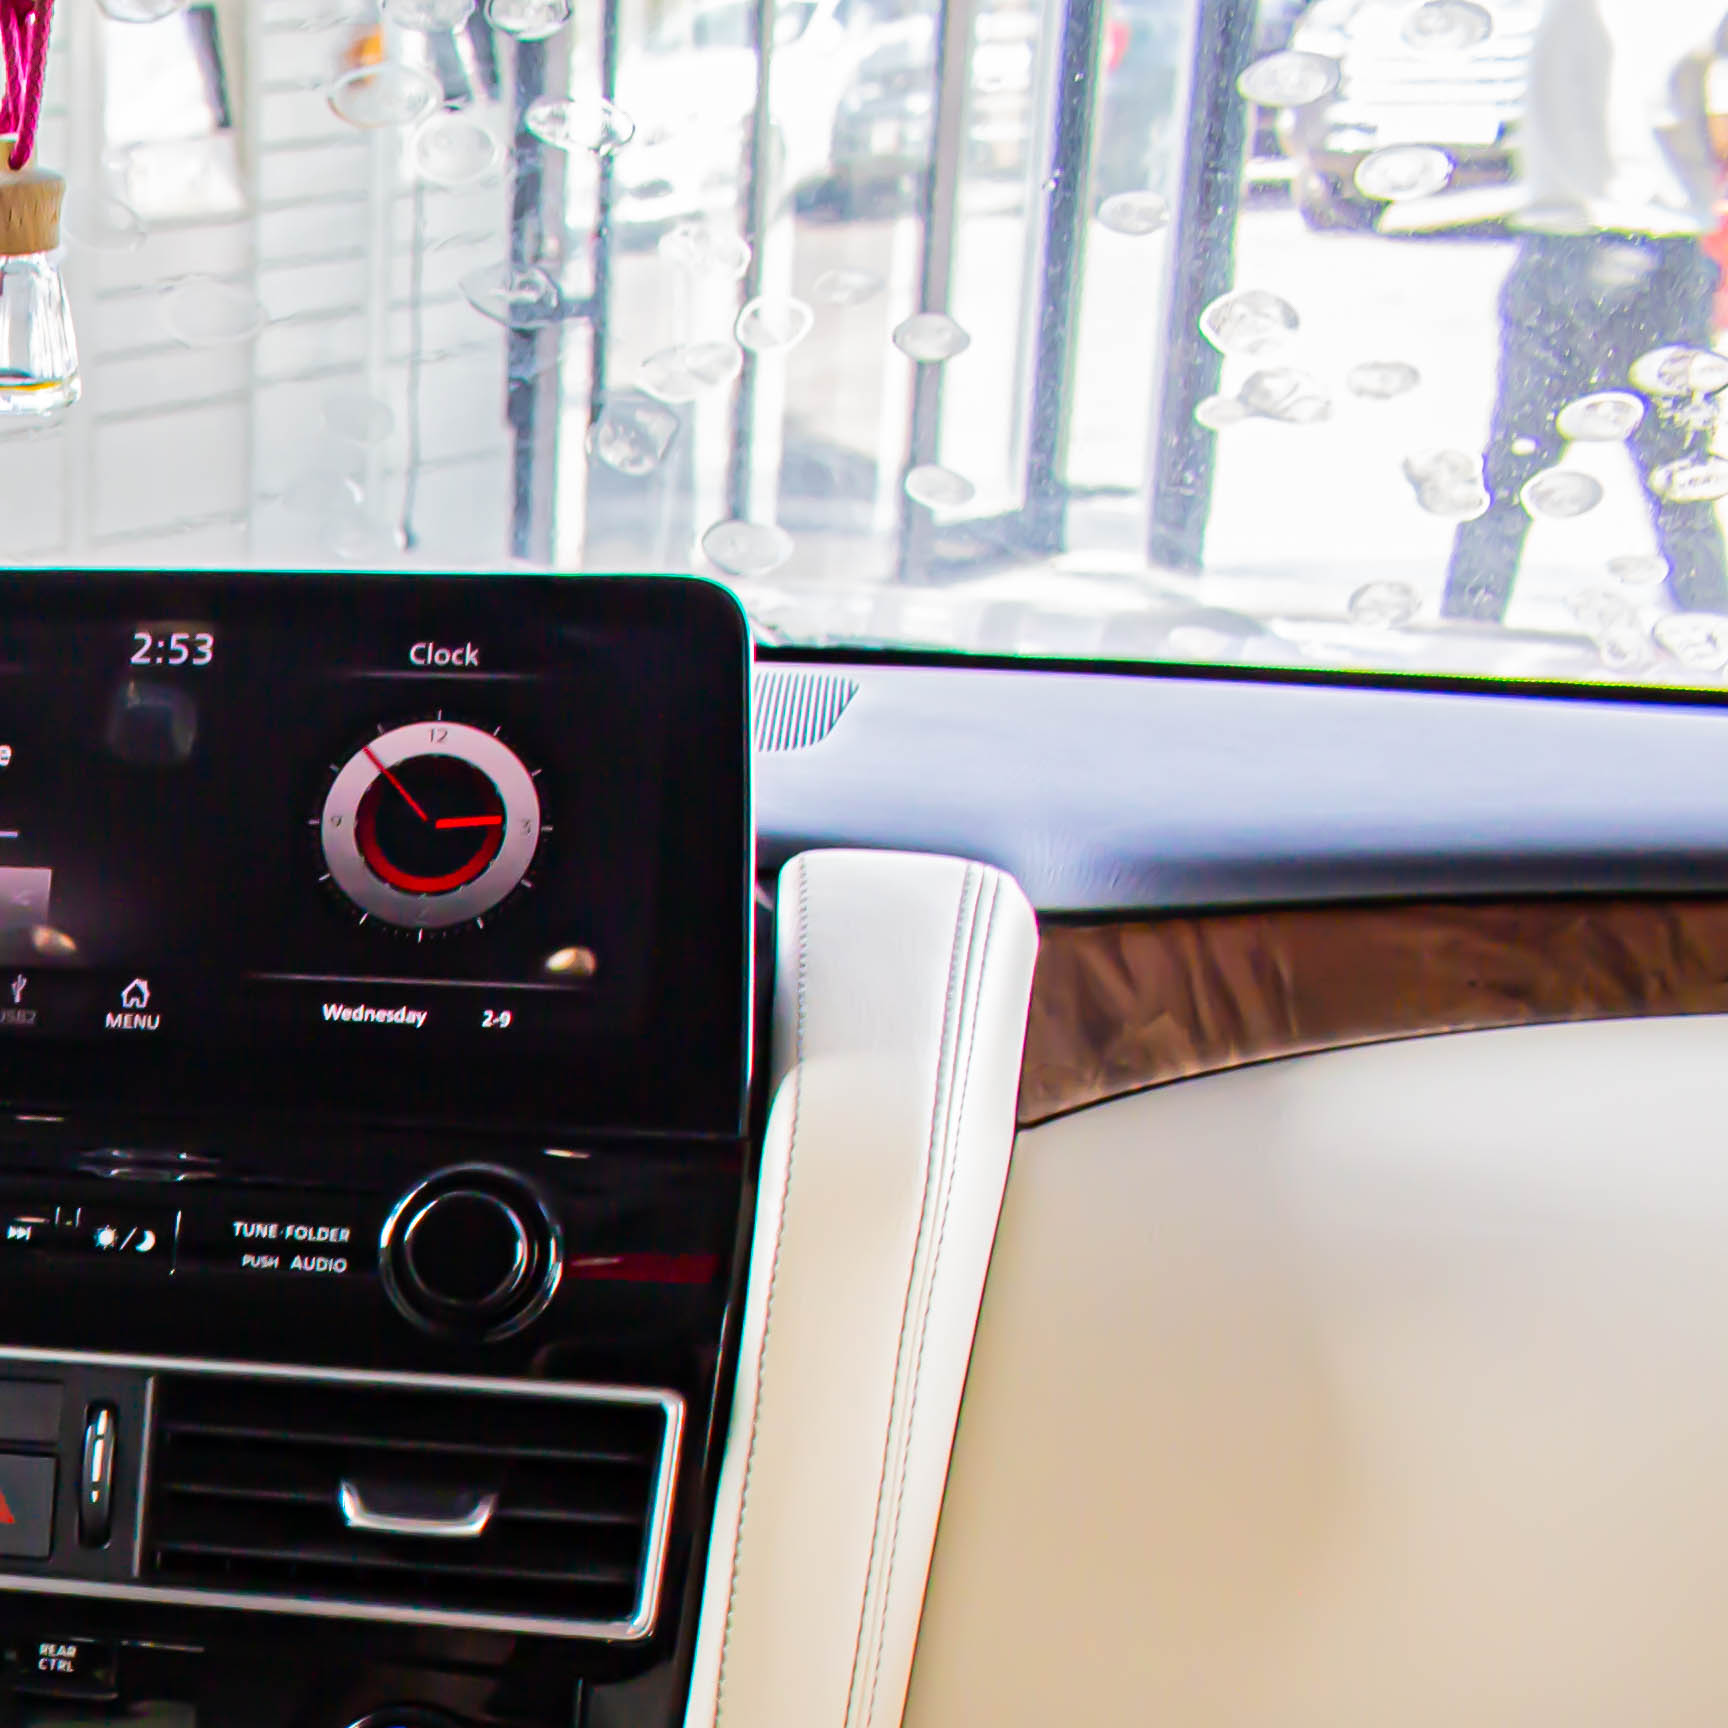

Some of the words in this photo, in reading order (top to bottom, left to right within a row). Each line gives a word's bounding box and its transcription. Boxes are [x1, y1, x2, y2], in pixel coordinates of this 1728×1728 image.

[130, 632, 215, 666] 2:53
[409, 642, 479, 667] Clock
[105, 1012, 161, 1031] MENU
[321, 1003, 428, 1028] Wednesday
[481, 1009, 513, 1029] 2-9
[241, 1253, 281, 1270] PUSH
[289, 1253, 348, 1274] AUDIO
[38, 1642, 77, 1658] REAR
[37, 1657, 76, 1673] CTRL
